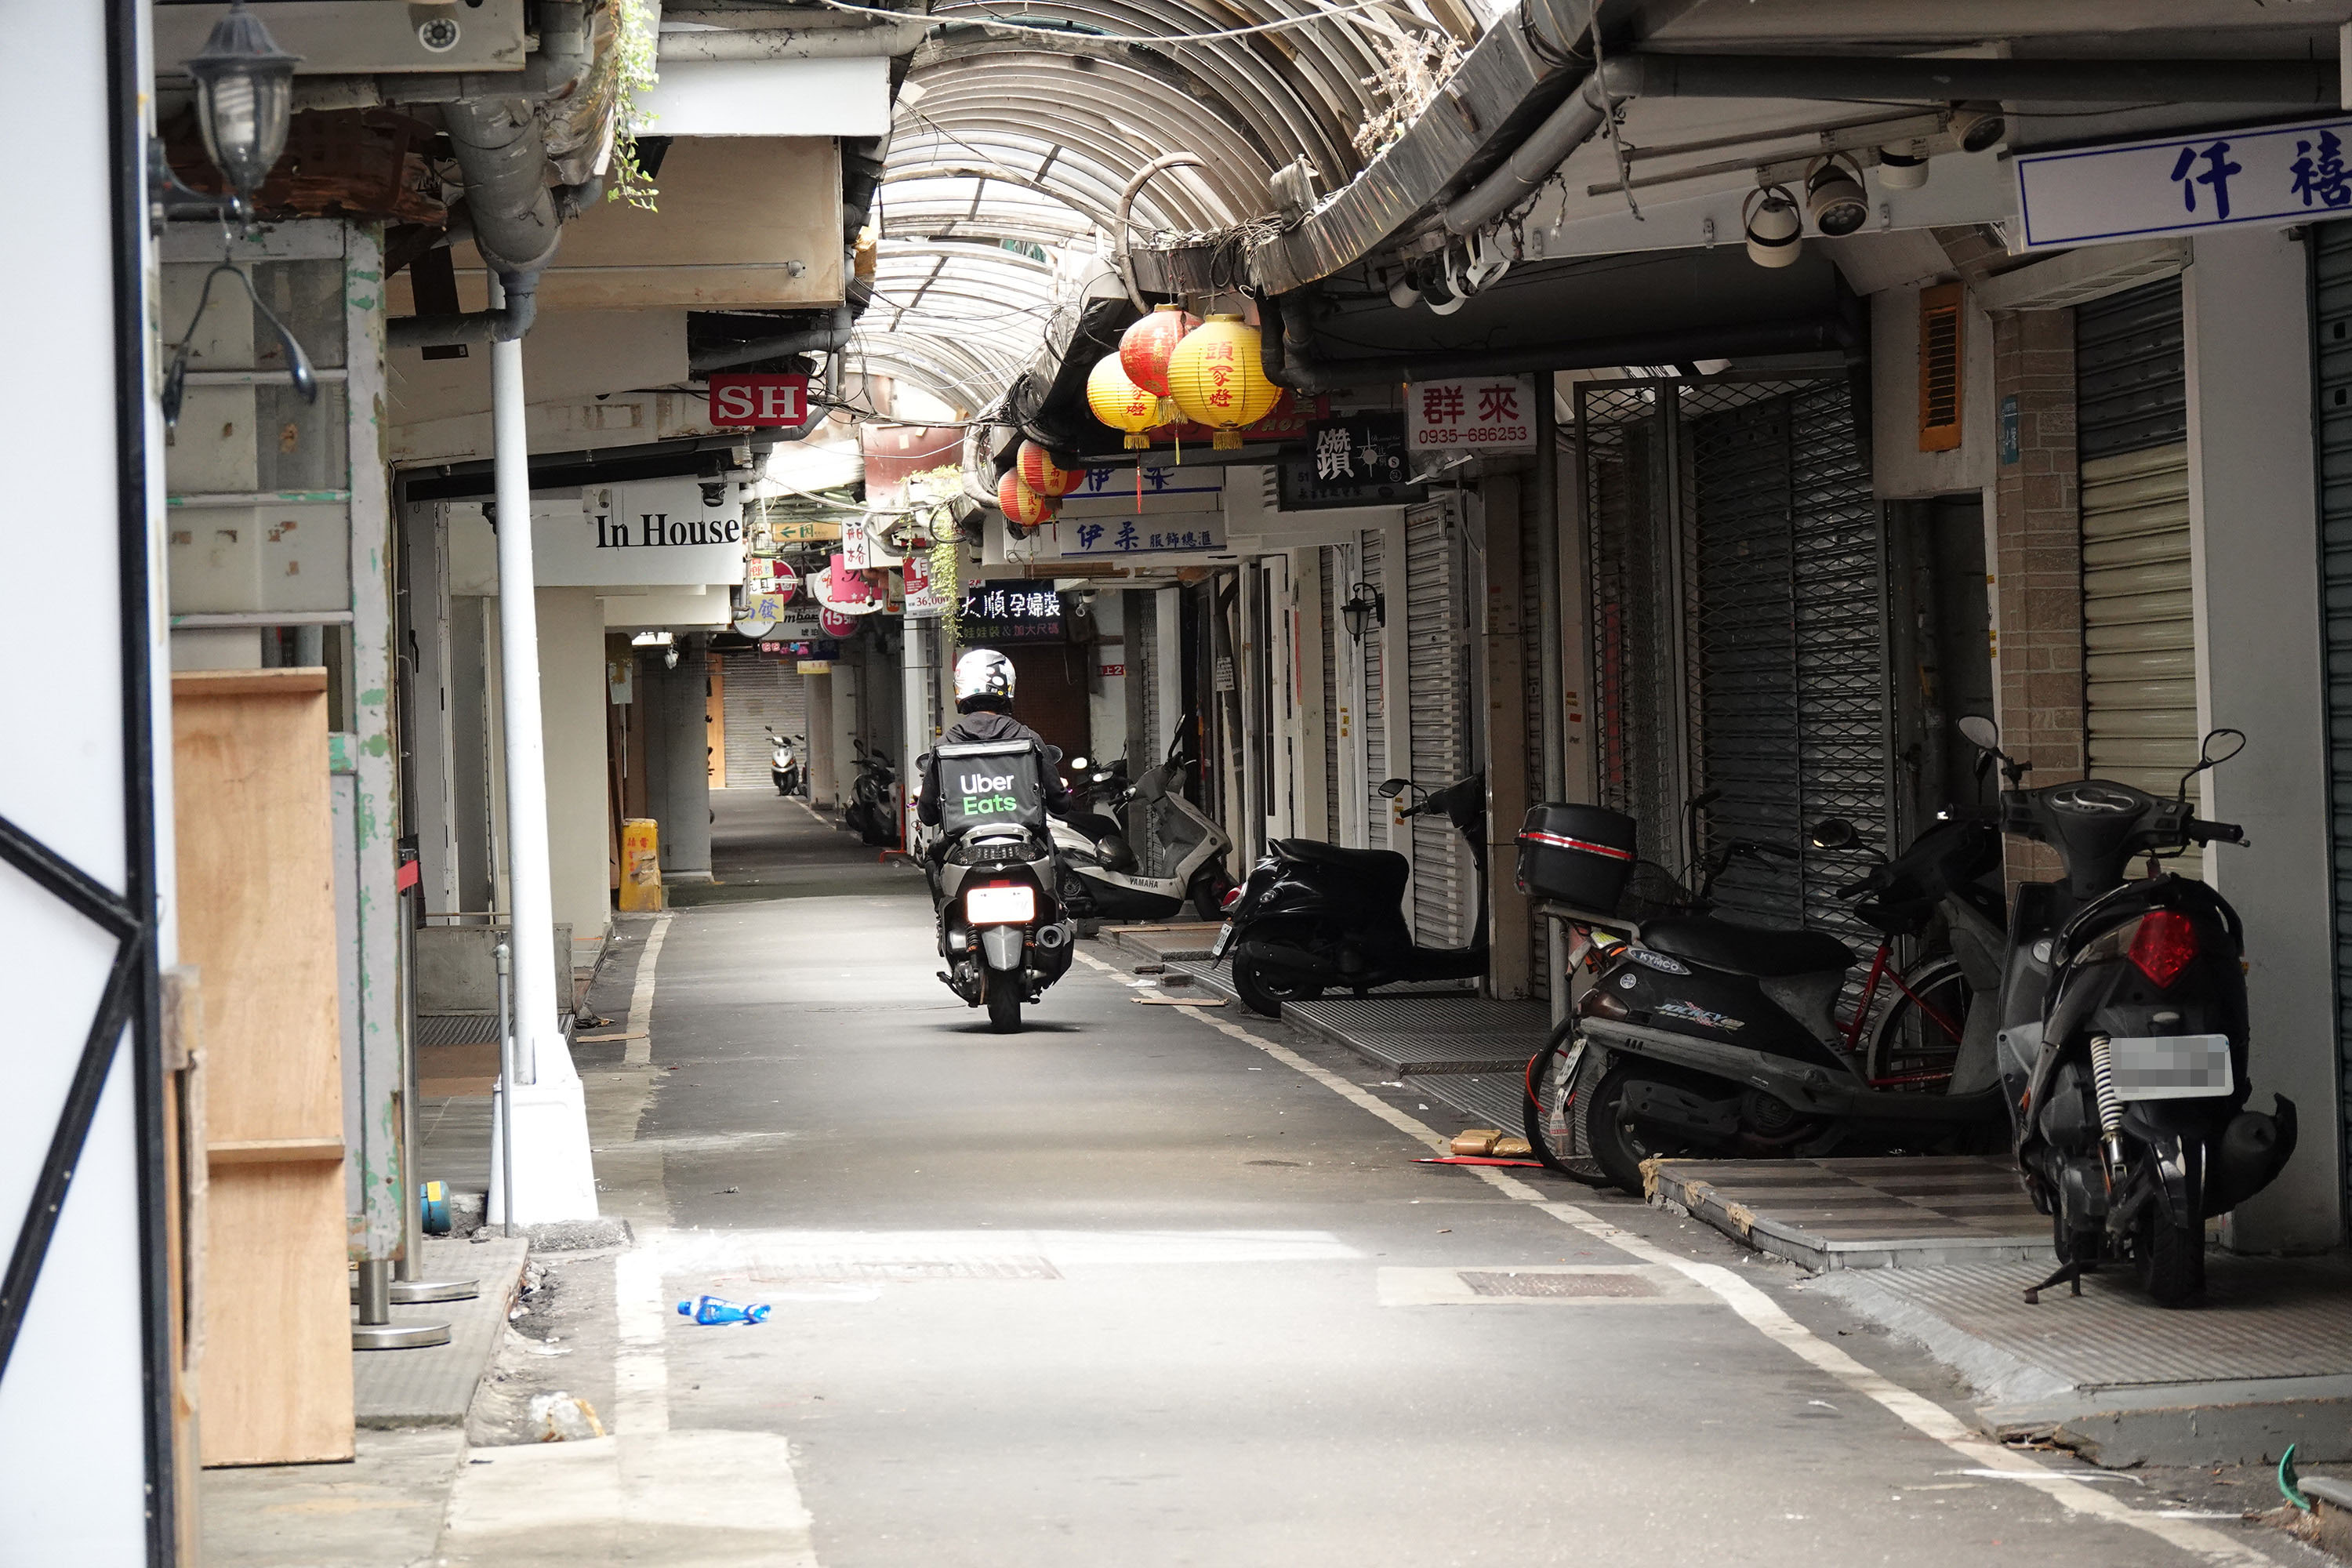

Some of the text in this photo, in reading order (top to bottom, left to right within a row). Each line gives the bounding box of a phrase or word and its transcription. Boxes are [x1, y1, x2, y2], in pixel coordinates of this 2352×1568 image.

[2171, 130, 2352, 220] 仟禧
[1205, 341, 1234, 408] 頭家燈
[718, 385, 800, 419] SH
[1423, 384, 1519, 424] 群來
[1418, 426, 1528, 444] 0935-686253
[1316, 427, 1355, 481] 鑽
[595, 514, 740, 548] In House
[1076, 521, 1140, 550] 伊柔
[960, 772, 1014, 795] Uber
[964, 794, 1017, 816] Eats
[1129, 877, 1159, 889] YAMAHA
[1639, 952, 1679, 971] KYMCO
